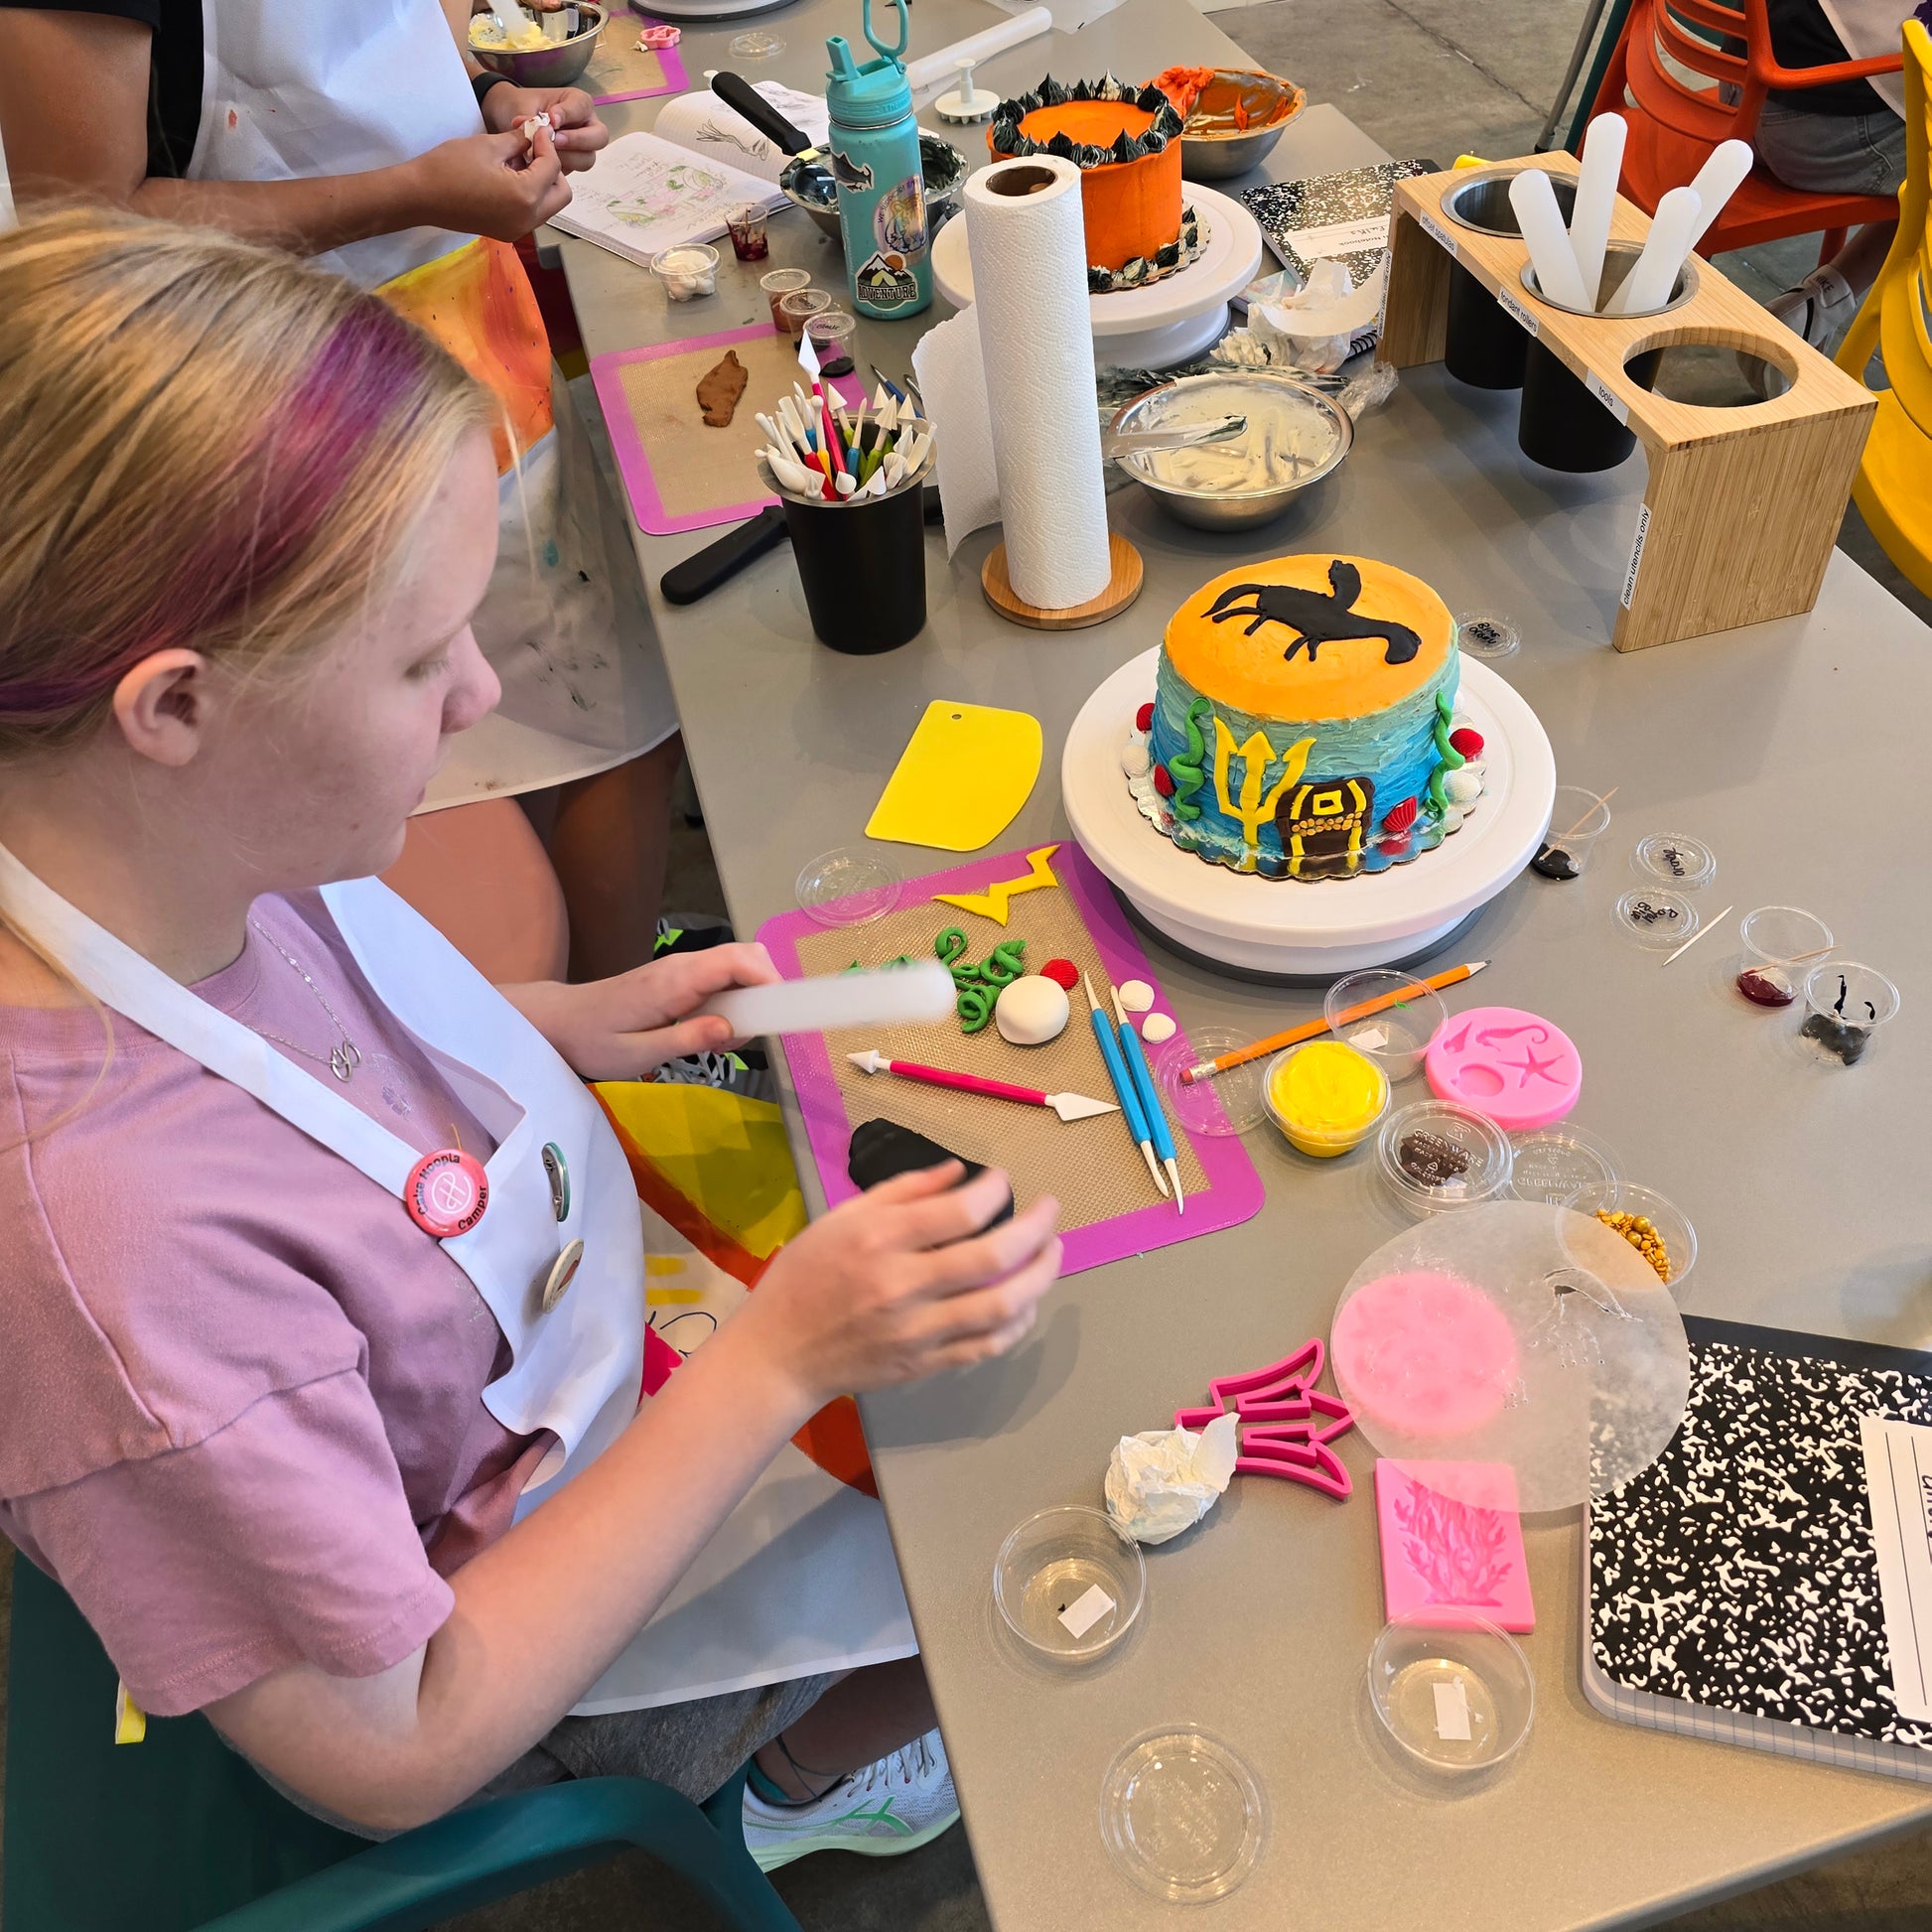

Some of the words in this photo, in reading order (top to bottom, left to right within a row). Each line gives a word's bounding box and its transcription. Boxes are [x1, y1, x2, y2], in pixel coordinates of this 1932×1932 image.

[858, 284, 916, 301] ADVENTURE
[1500, 289, 1521, 317] fondant
[1520, 311, 1538, 334] rollers
[1598, 385, 1614, 407] tools
[1623, 576, 1635, 605] clean
[1630, 534, 1644, 576] utencils
[1639, 508, 1650, 533] only
[419, 1153, 461, 1180] Hoopla
[413, 1181, 428, 1215] Cake
[458, 1185, 487, 1230] Camper
